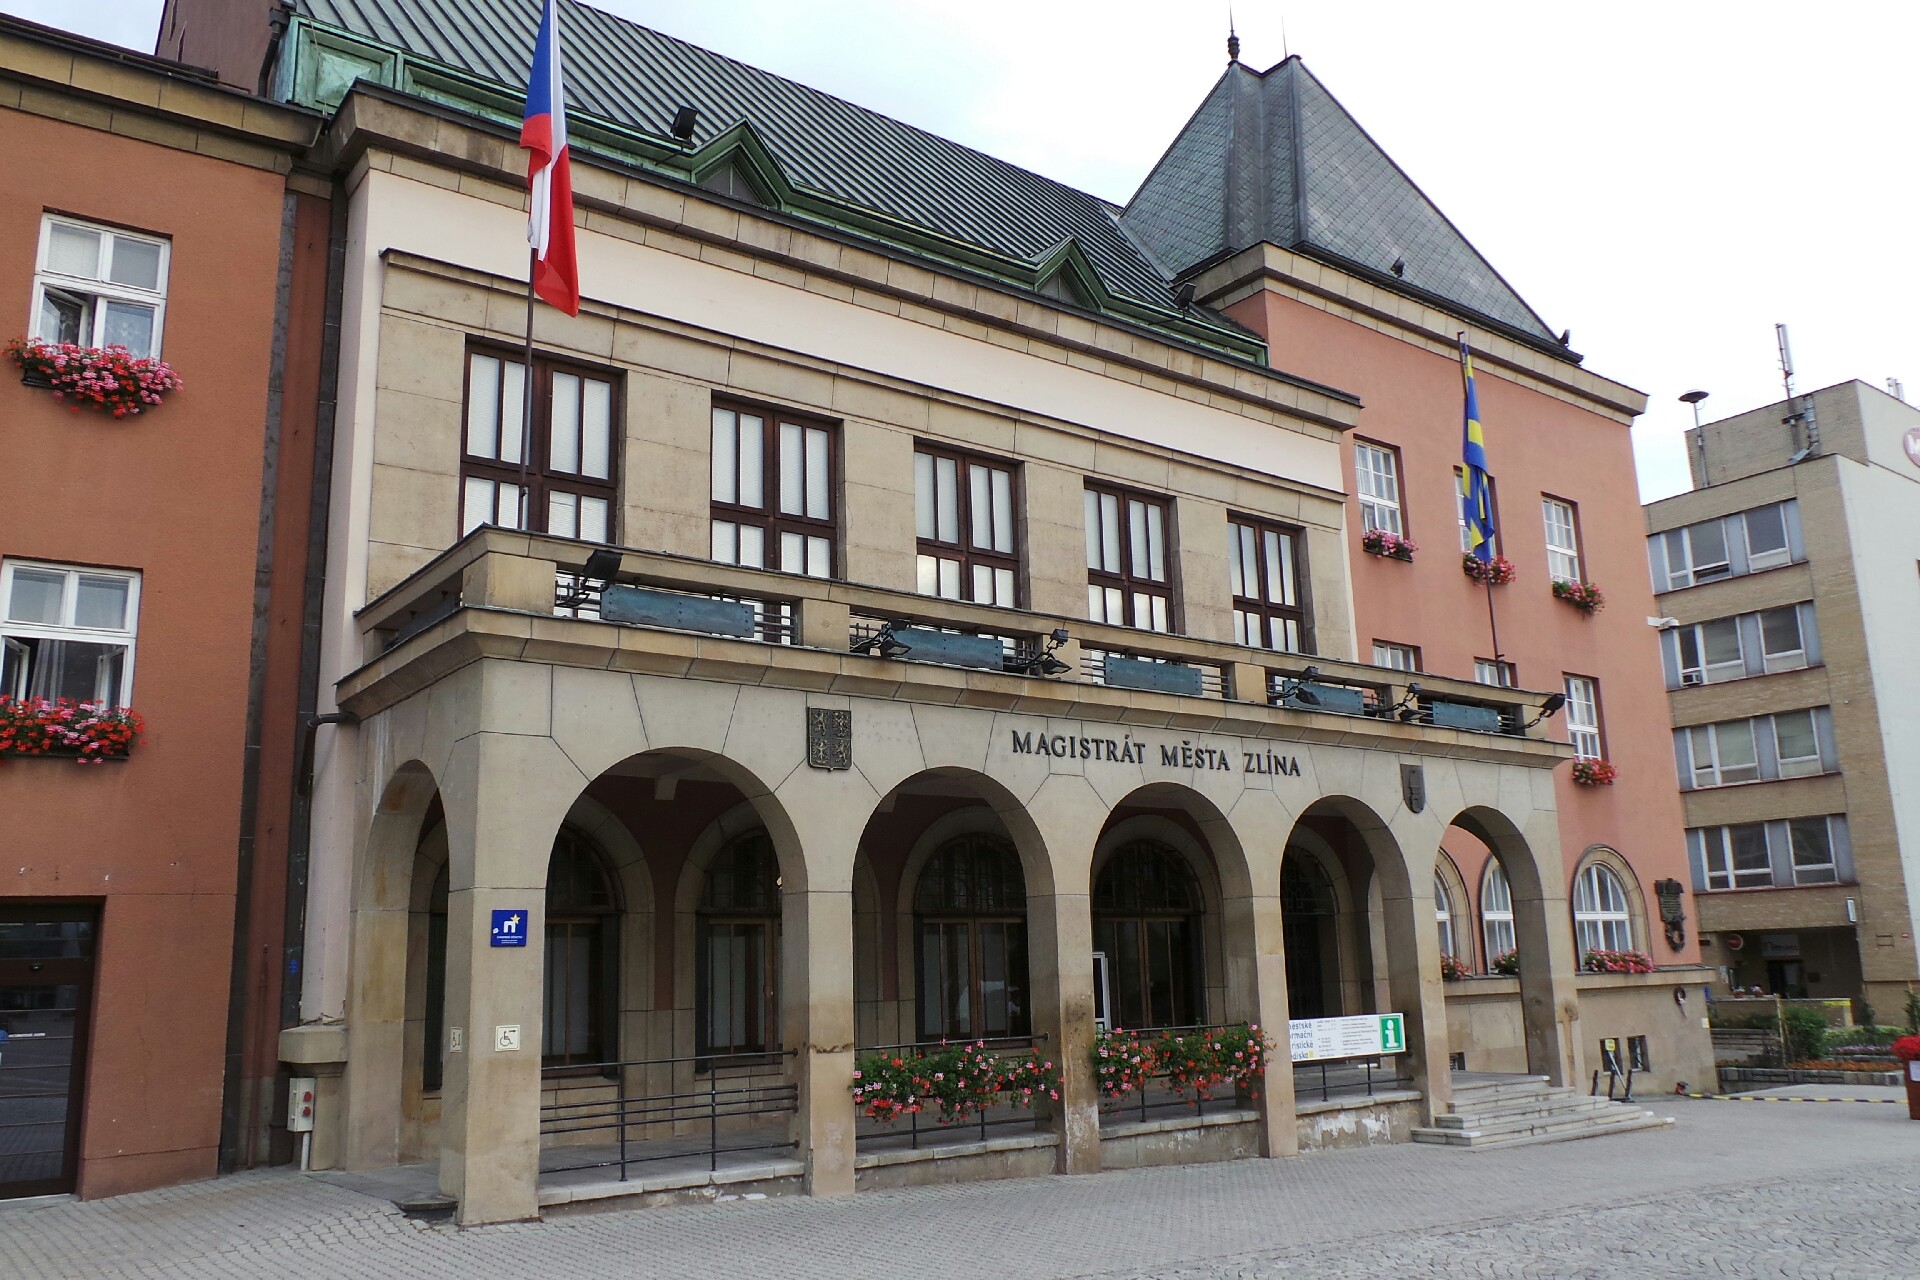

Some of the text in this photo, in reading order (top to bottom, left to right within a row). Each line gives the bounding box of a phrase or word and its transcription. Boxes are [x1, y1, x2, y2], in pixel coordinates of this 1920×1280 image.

[1012, 730, 1301, 777] MAGISTRÁT MĚSTA ZLÍNA
